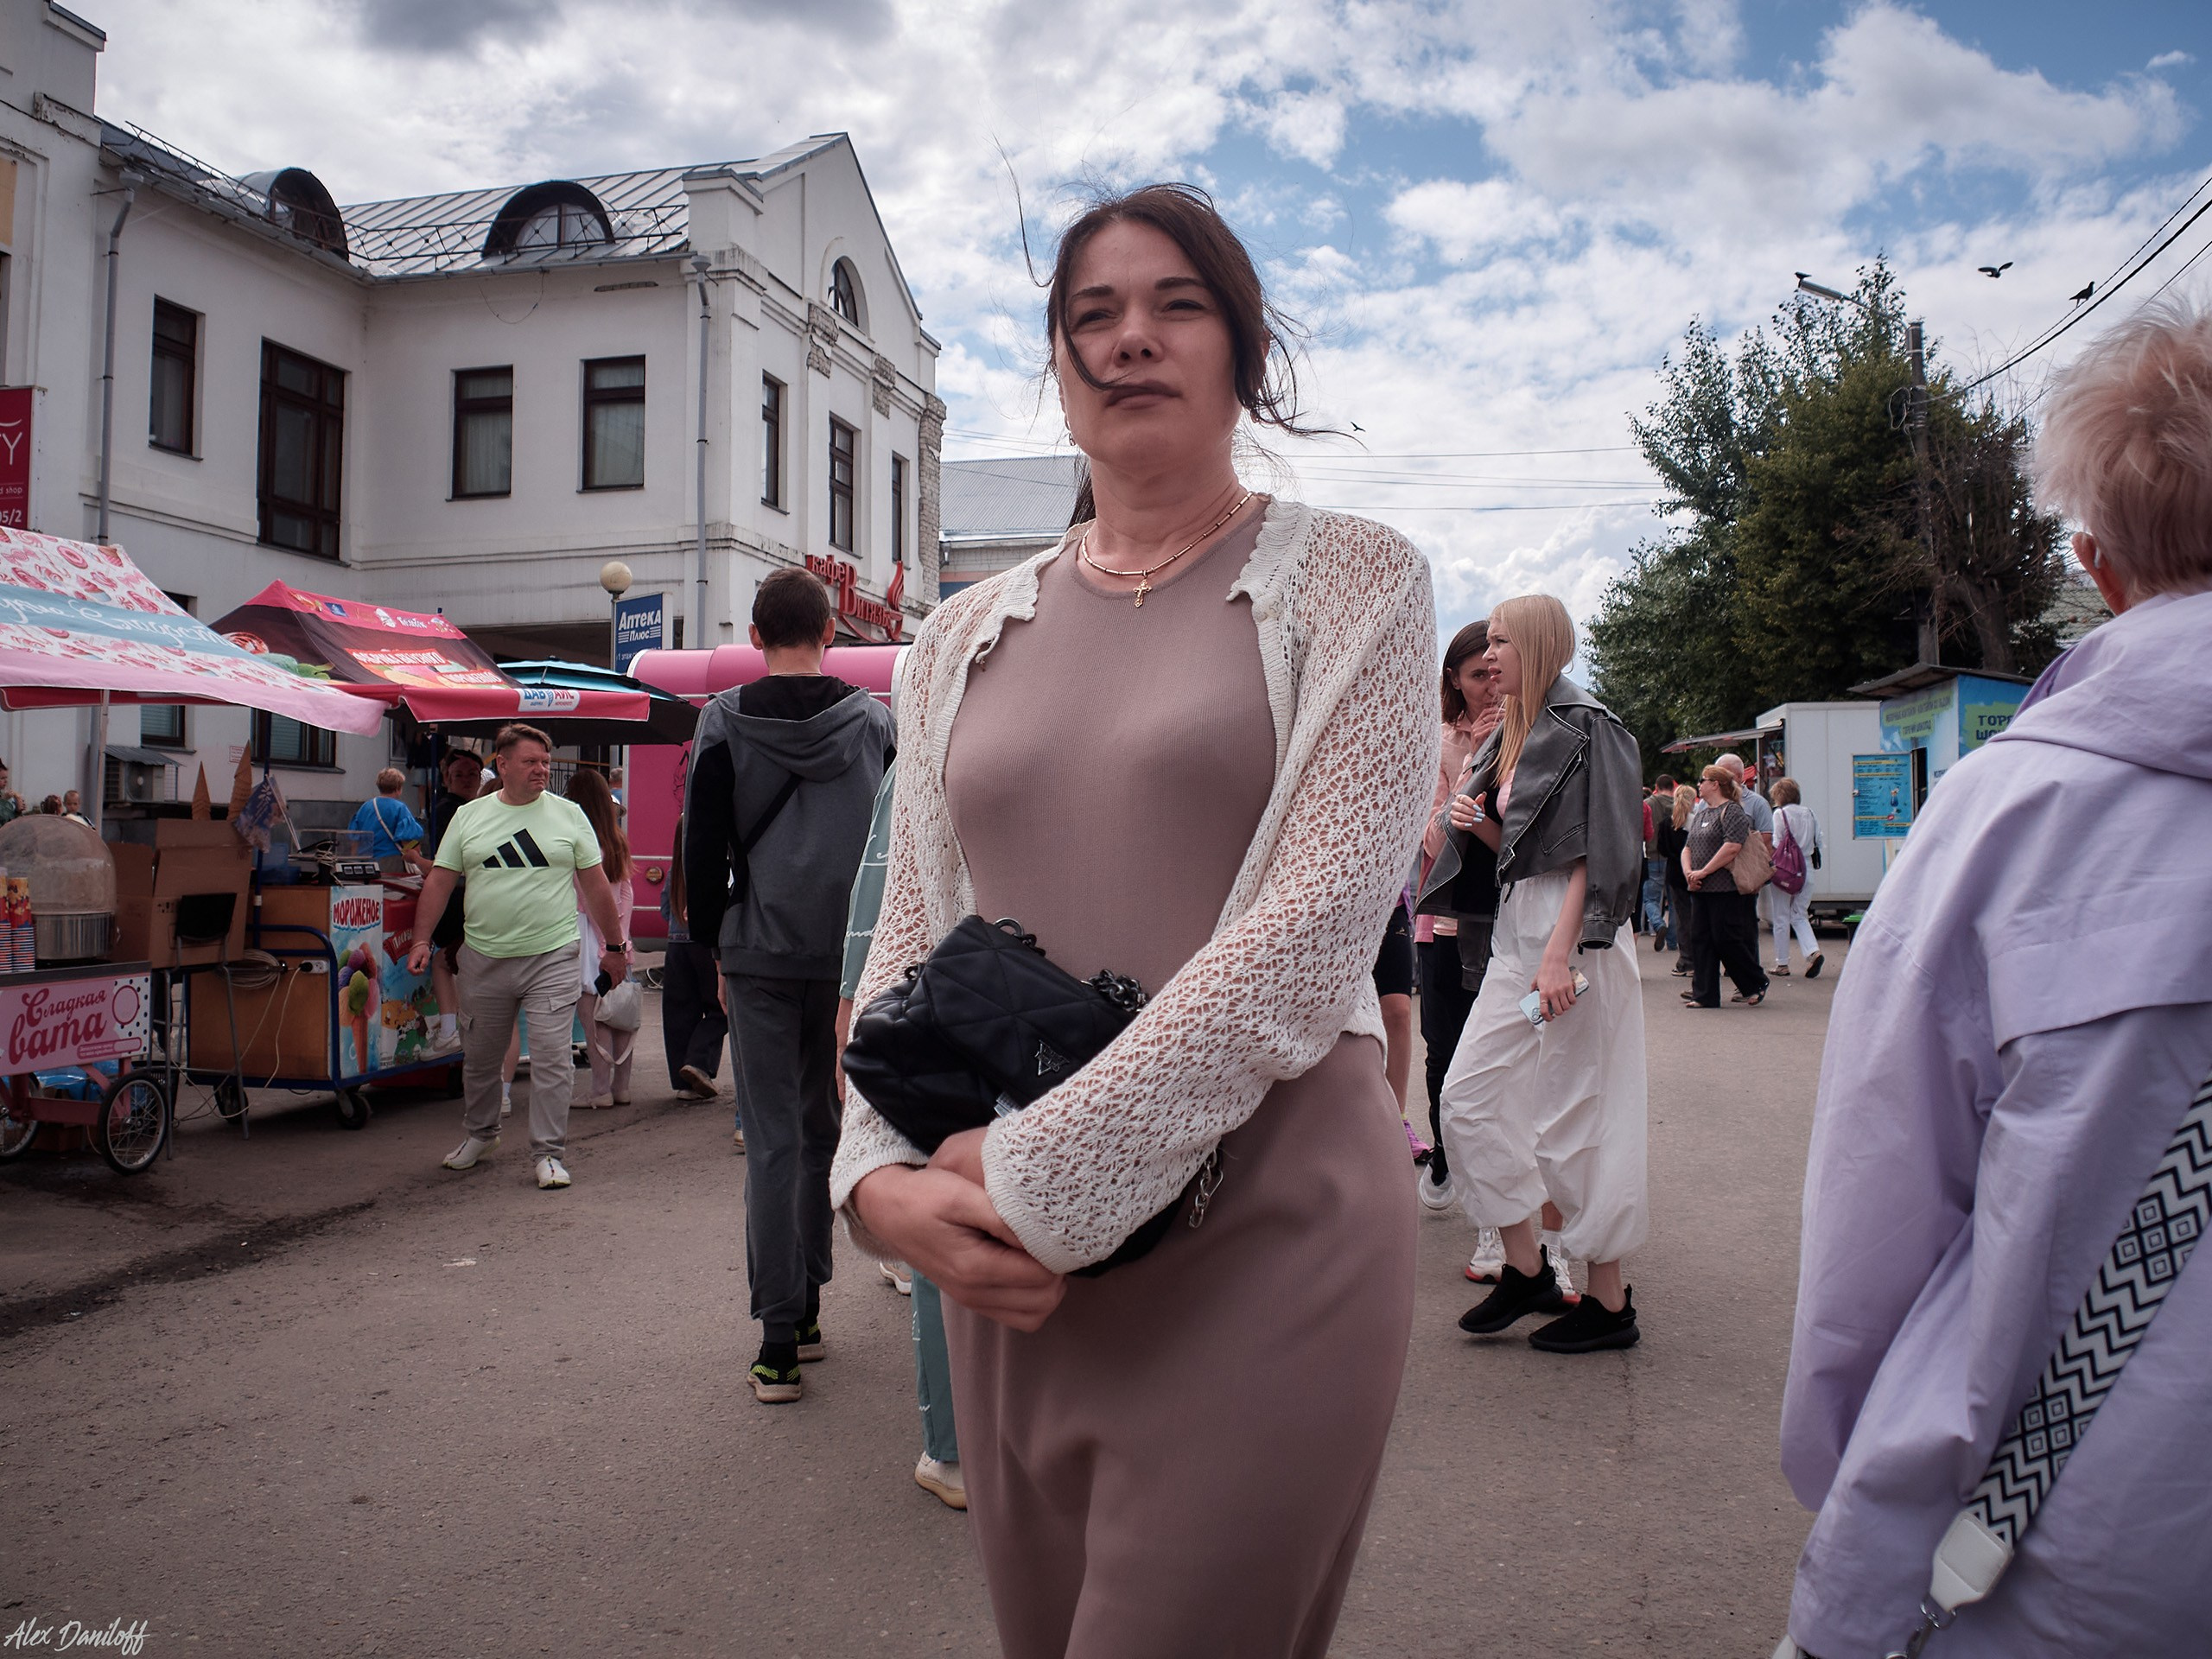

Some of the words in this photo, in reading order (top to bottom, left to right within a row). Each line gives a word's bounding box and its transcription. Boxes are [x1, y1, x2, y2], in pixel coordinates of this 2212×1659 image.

[5, 486, 22, 495] shop
[805, 554, 846, 586] кафе
[333, 897, 380, 928] МОРОЖЕНОЕ
[22, 988, 107, 1028] Сладкая
